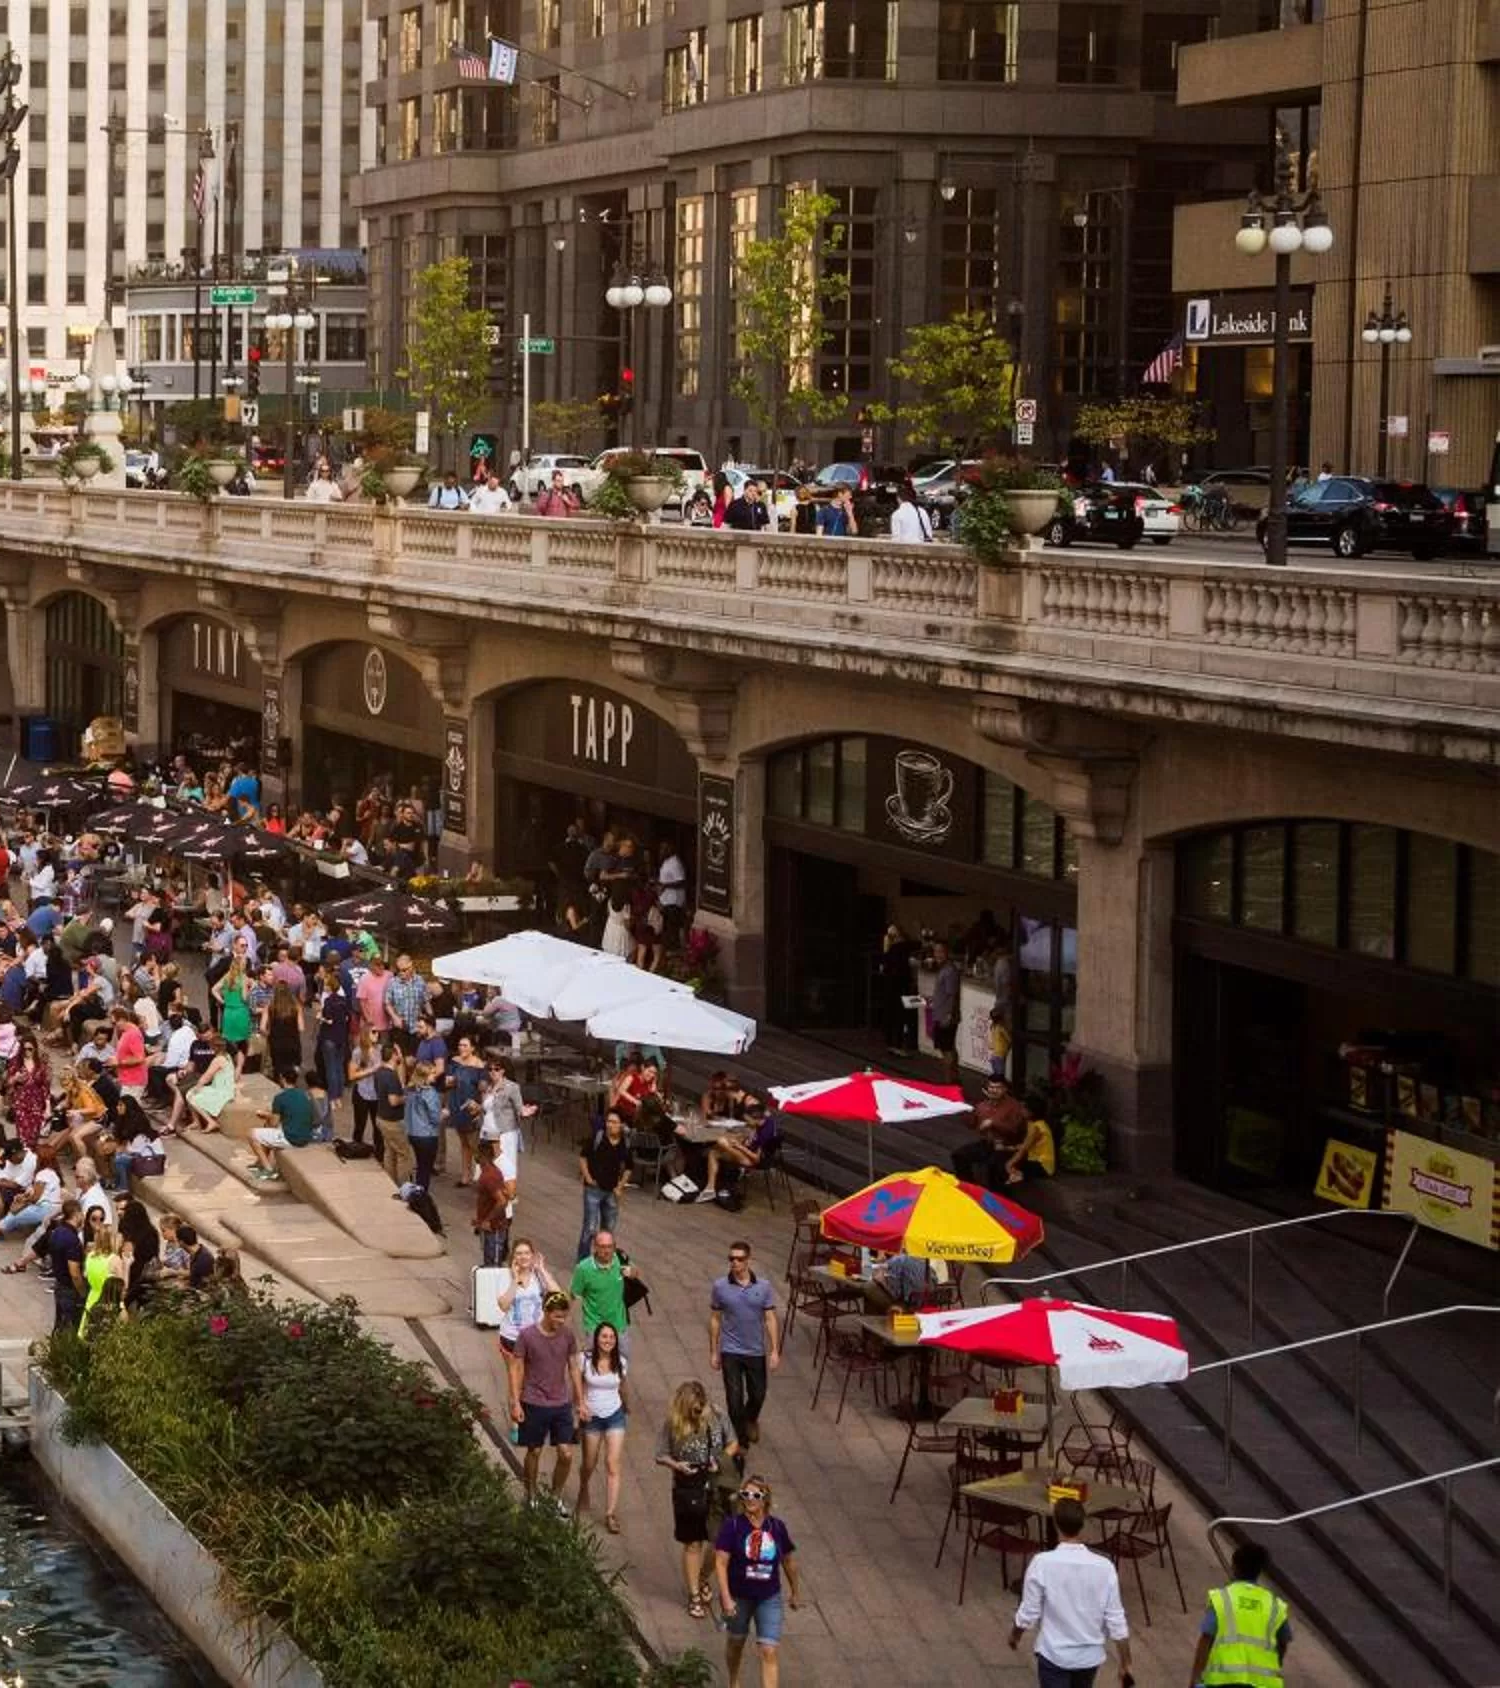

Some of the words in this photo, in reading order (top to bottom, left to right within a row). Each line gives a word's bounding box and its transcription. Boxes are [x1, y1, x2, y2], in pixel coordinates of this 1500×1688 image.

[1212, 311, 1268, 334] Lakeside
[193, 623, 239, 678] TINY
[570, 694, 633, 767] TAPP
